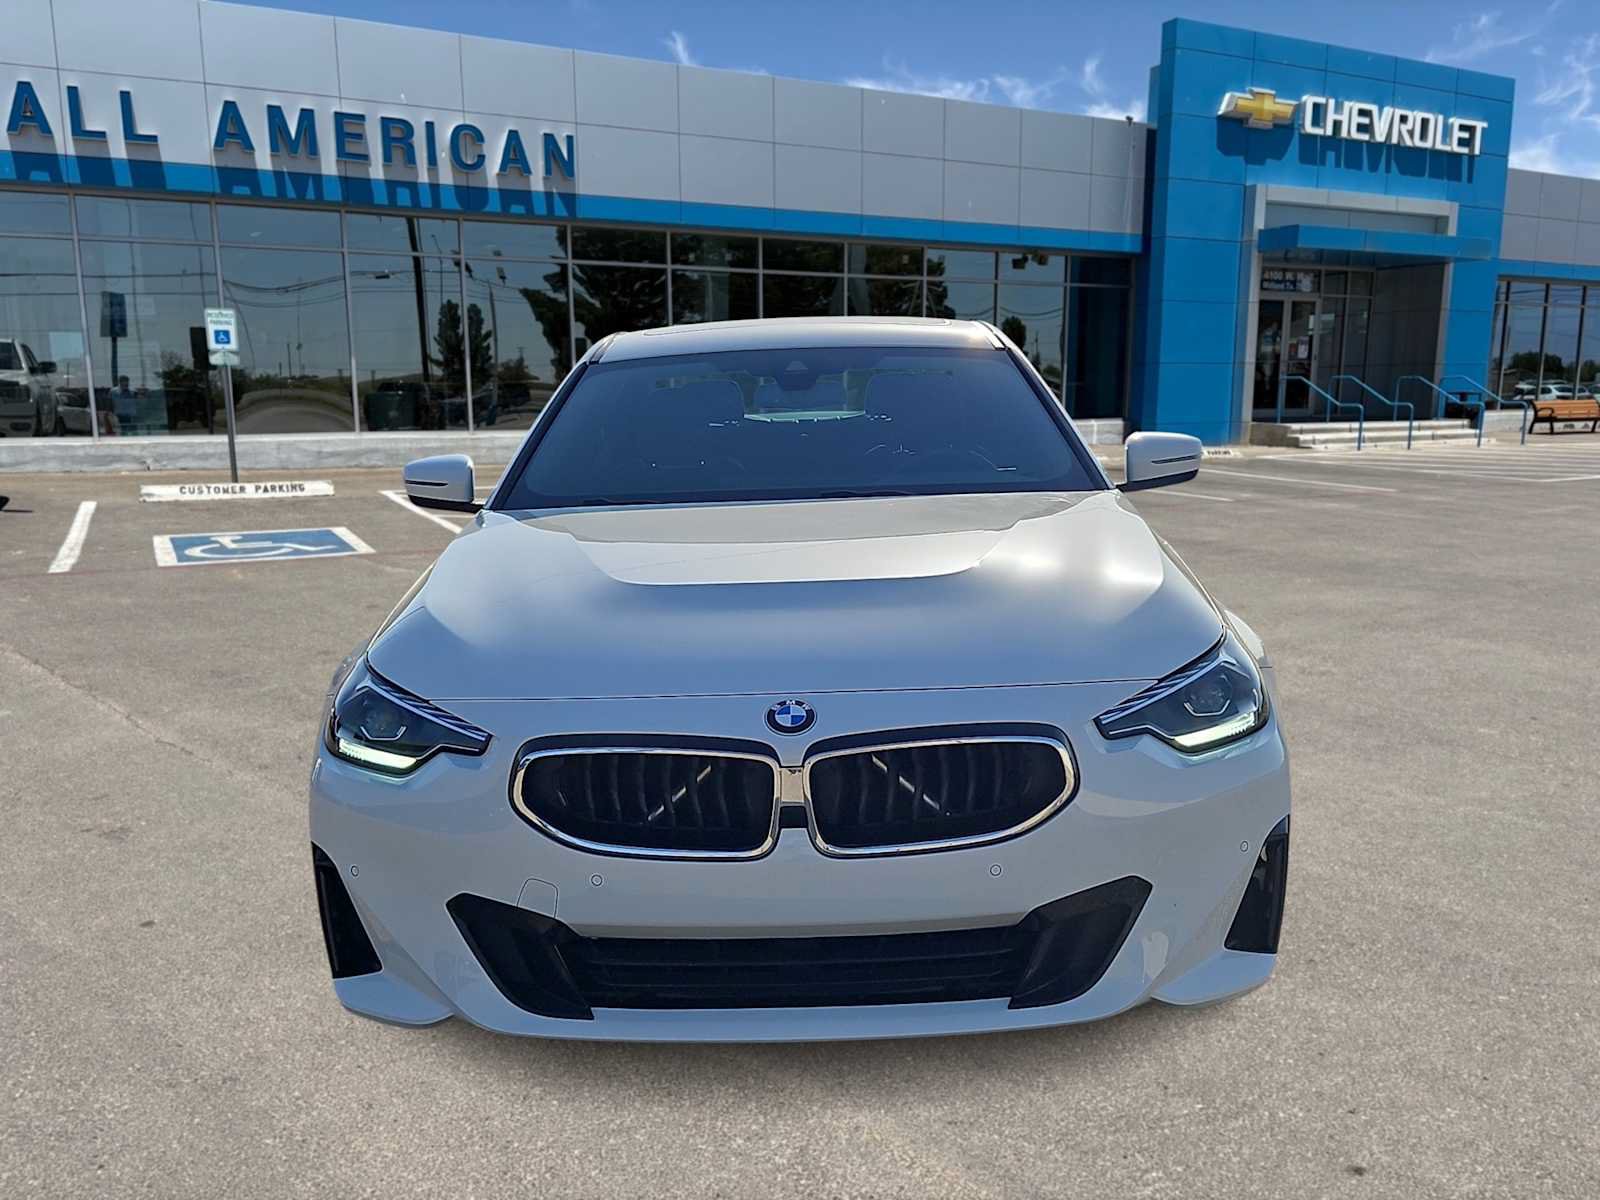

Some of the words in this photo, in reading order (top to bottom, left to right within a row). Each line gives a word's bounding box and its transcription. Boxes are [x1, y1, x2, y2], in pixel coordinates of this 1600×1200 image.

[7, 81, 158, 144] ALL
[213, 100, 575, 179] AMERICAN
[1301, 94, 1488, 155] CHEVROLET
[179, 485, 246, 495] CUSTOMER
[255, 482, 305, 493] PARKING
